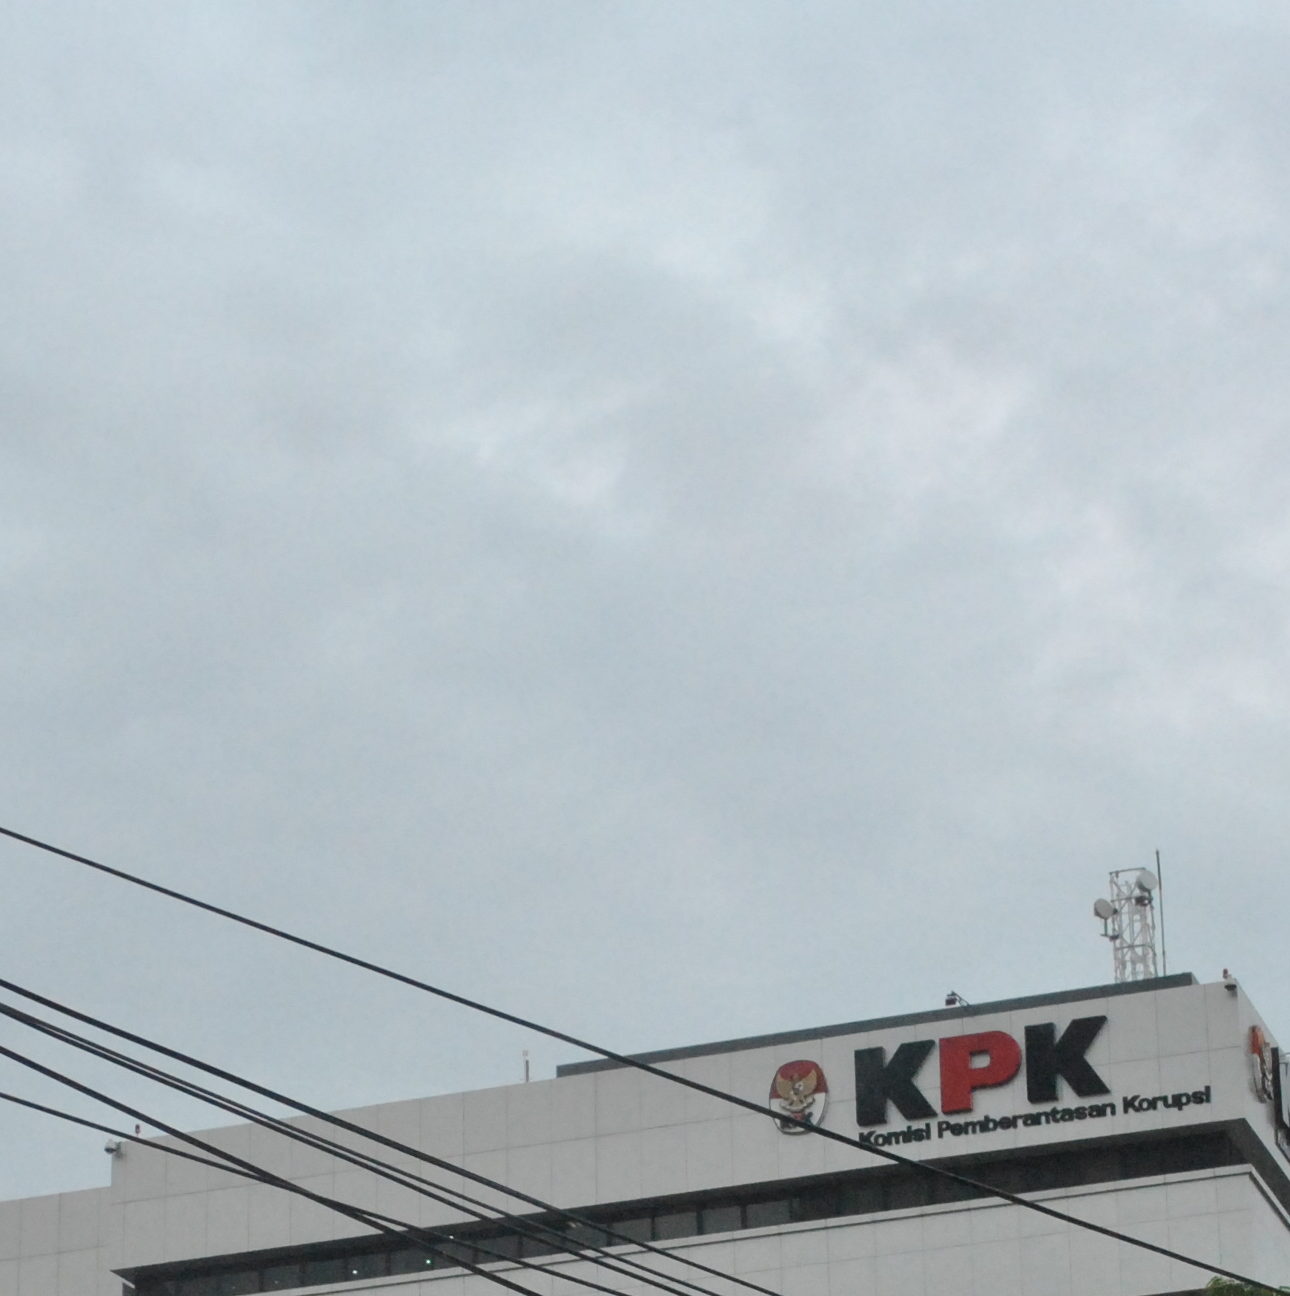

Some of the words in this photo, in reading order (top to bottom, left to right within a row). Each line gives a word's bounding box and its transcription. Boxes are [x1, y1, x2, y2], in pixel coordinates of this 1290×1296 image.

[854, 1015, 1111, 1127] KPK
[859, 1123, 931, 1149] Komisi
[937, 1099, 1116, 1139] Pemberantasan
[1122, 1085, 1212, 1114] Korupsi
